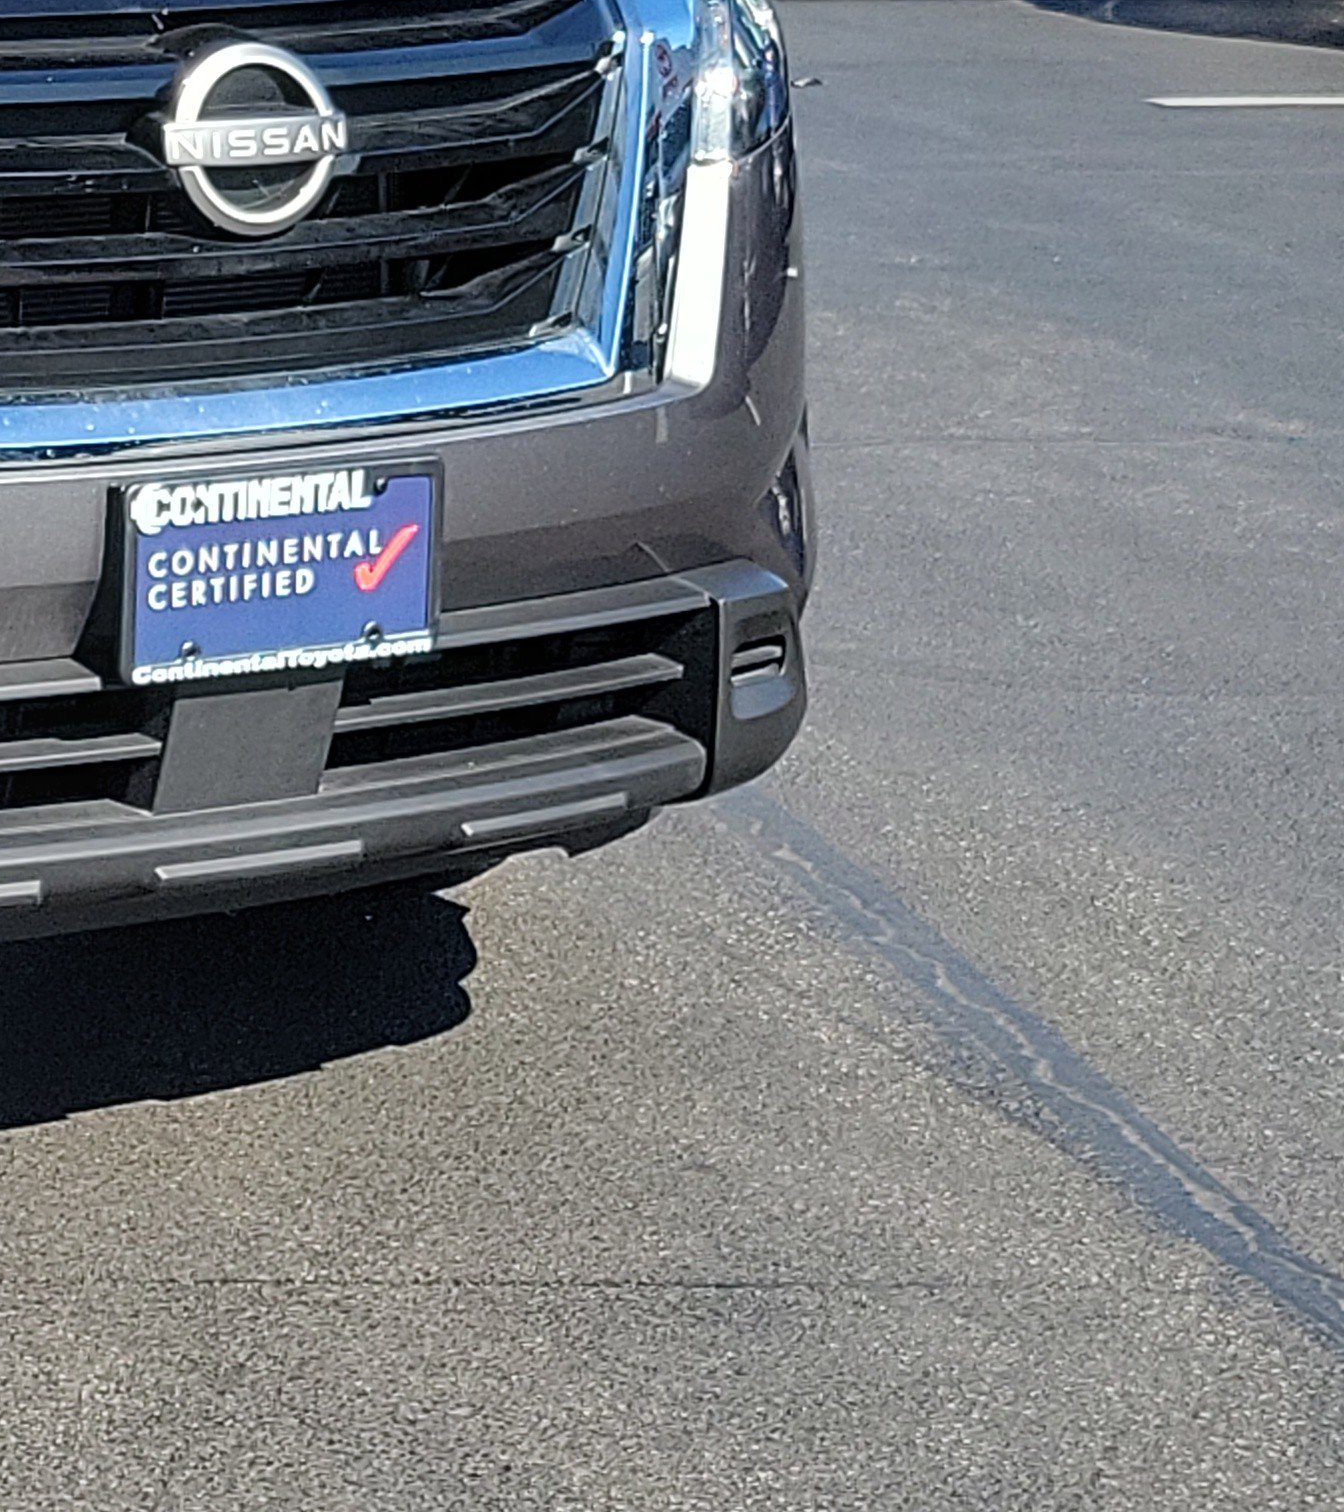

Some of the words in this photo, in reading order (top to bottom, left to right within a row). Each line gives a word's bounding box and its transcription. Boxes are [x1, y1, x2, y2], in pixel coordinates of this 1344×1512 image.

[172, 121, 345, 160] NISSAN
[130, 468, 373, 535] CONTINENTAL
[147, 529, 384, 578] CONTINENTAL
[147, 569, 316, 611] CERTIFIED
[131, 636, 433, 686] ContinentalToyota.com
